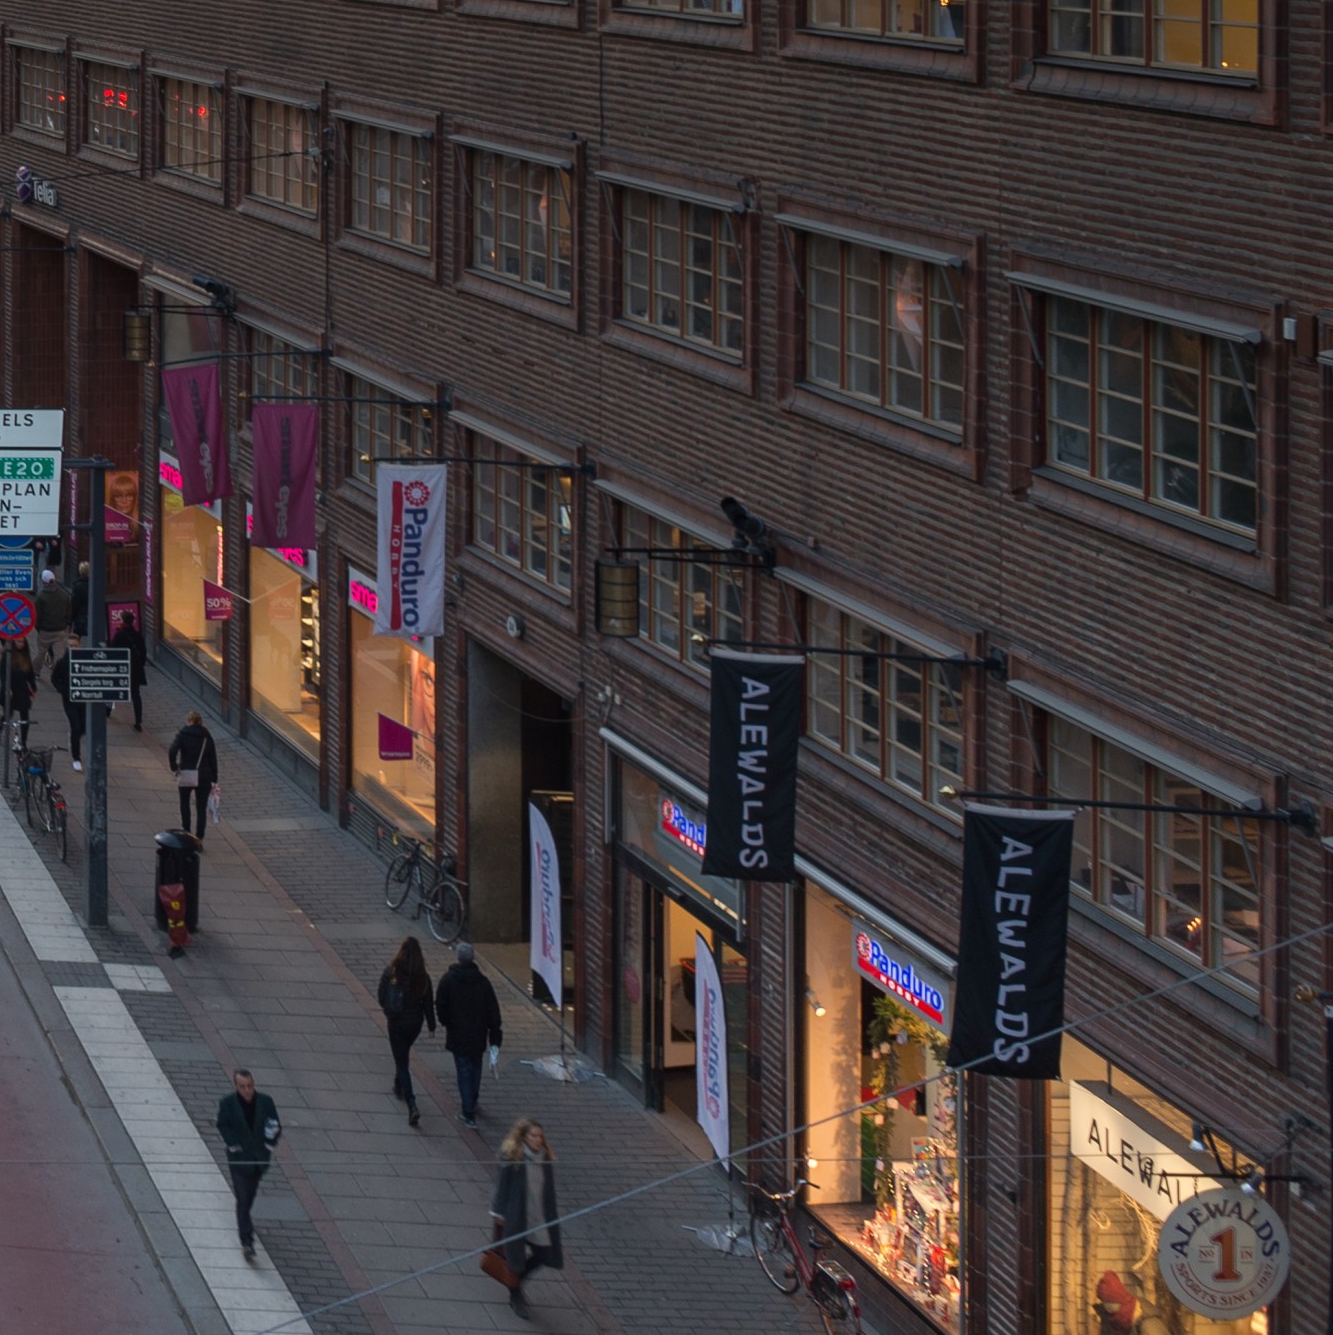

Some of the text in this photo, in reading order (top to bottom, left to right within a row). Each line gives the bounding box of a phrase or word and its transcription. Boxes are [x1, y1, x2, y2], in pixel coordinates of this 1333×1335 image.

[32, 177, 55, 205] Telia
[3, 462, 44, 475] E20
[391, 525, 401, 588] HOBBY
[401, 508, 428, 627] Panduro
[738, 676, 770, 869] ALEWALDS
[672, 804, 707, 847] Pand
[871, 939, 944, 1012] Panduro
[993, 835, 1033, 1065] ALEWALDS
[1088, 1117, 1182, 1205] ALEWAL
[1170, 1198, 1280, 1259] ALEWALDS
[1209, 1226, 1242, 1282] 1
[1240, 1249, 1253, 1259] IN
[1176, 1262, 1218, 1305] SPORTS
[1219, 1288, 1257, 1306] SINCE
